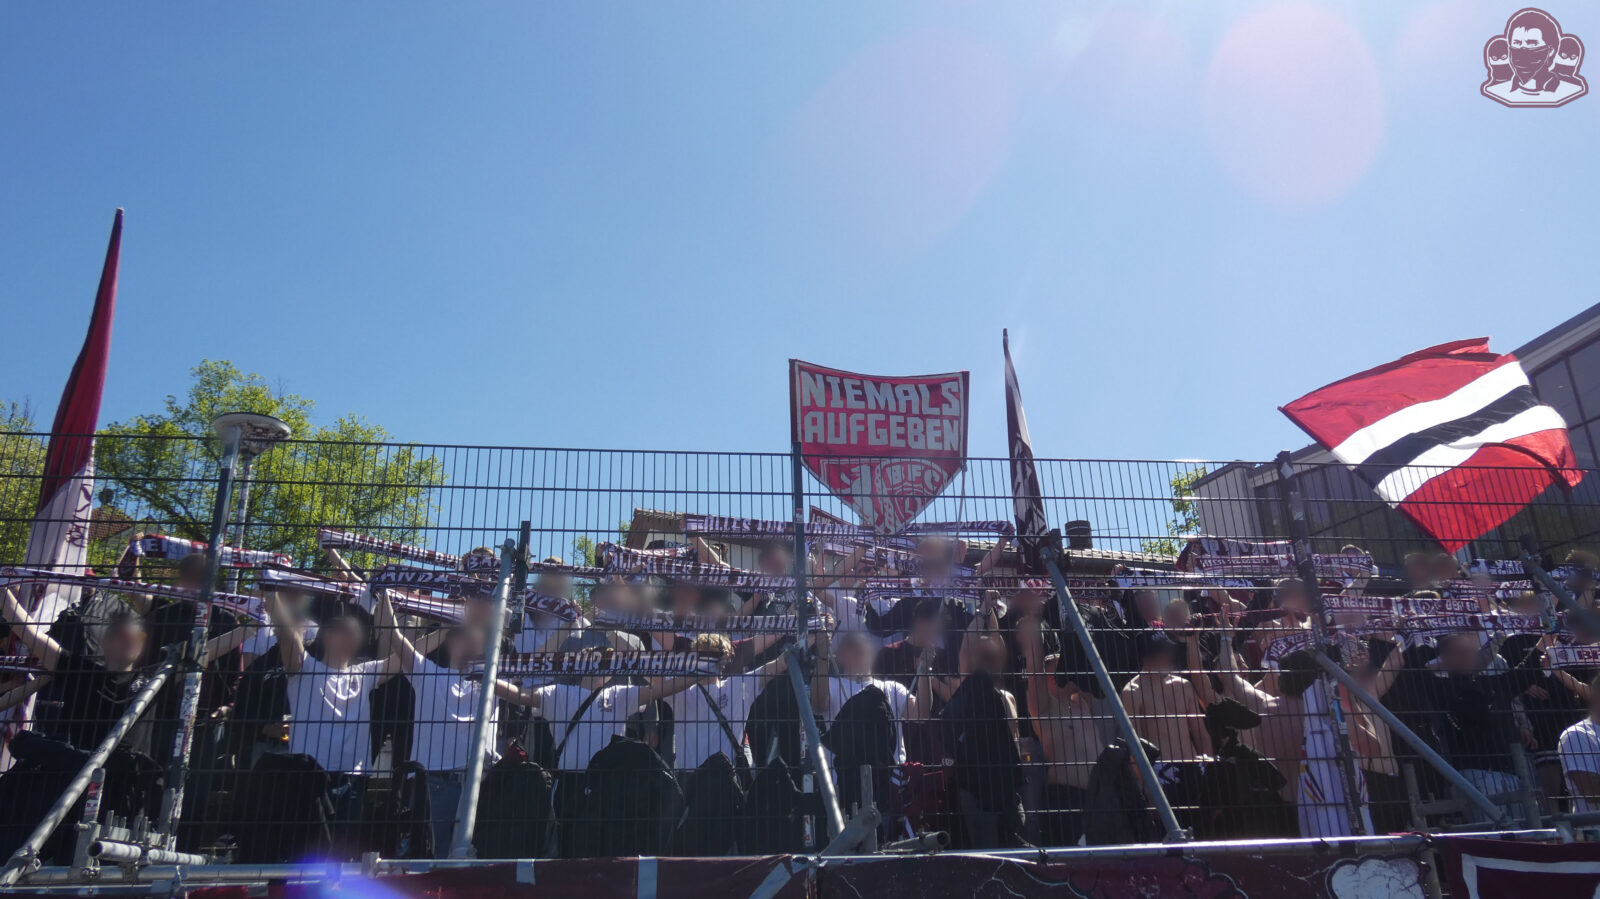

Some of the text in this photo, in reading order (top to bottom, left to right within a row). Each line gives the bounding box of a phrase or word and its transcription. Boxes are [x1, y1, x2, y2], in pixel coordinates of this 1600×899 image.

[801, 370, 960, 417] NIEMALS
[804, 411, 959, 451] AUFGEBEN
[886, 464, 940, 492] BFC
[727, 615, 798, 630] DYNAM
[562, 652, 602, 671] FÜR
[610, 651, 698, 671] DYNAMO
